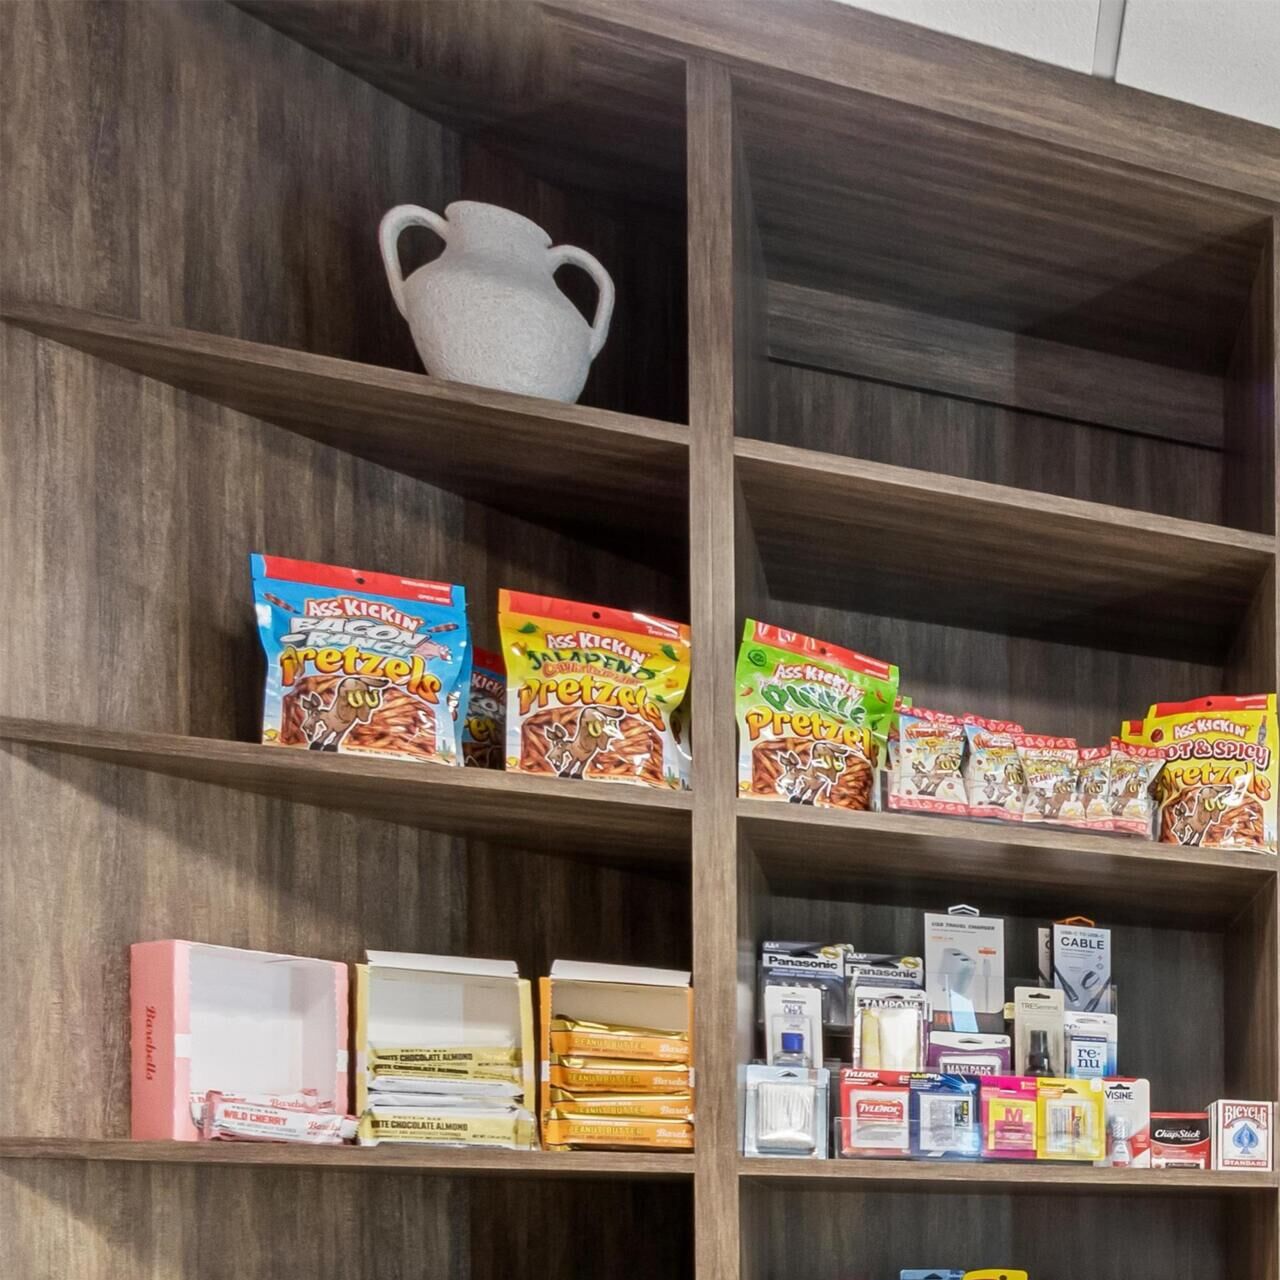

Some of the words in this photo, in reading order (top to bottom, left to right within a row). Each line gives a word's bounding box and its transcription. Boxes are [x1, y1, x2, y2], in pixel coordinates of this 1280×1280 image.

[308, 601, 343, 616] ASS
[291, 617, 430, 647] BACON
[547, 634, 577, 648] ASS
[776, 664, 803, 679] ASS
[1174, 725, 1196, 739] ASS
[1195, 741, 1212, 759] &
[1213, 741, 1269, 768] SPICY
[1061, 937, 1105, 950] CABLE
[768, 956, 838, 970] Panasonic
[851, 966, 917, 979] Panasonic
[144, 1005, 157, 1081] Barebells
[400, 1053, 441, 1062] CHOCOLATE
[1077, 1058, 1100, 1068] nu
[844, 1070, 879, 1079] TYLENOL
[1105, 1091, 1133, 1100] VISINE
[859, 1103, 899, 1113] TYLENOL
[223, 1109, 248, 1121] WILD
[249, 1112, 288, 1126] CHERRY
[1225, 1105, 1268, 1127] BICYCLE
[391, 1121, 434, 1130] CHOCOLATE
[436, 1122, 468, 1131] ALMOND
[1154, 1129, 1201, 1138] ChapStick
